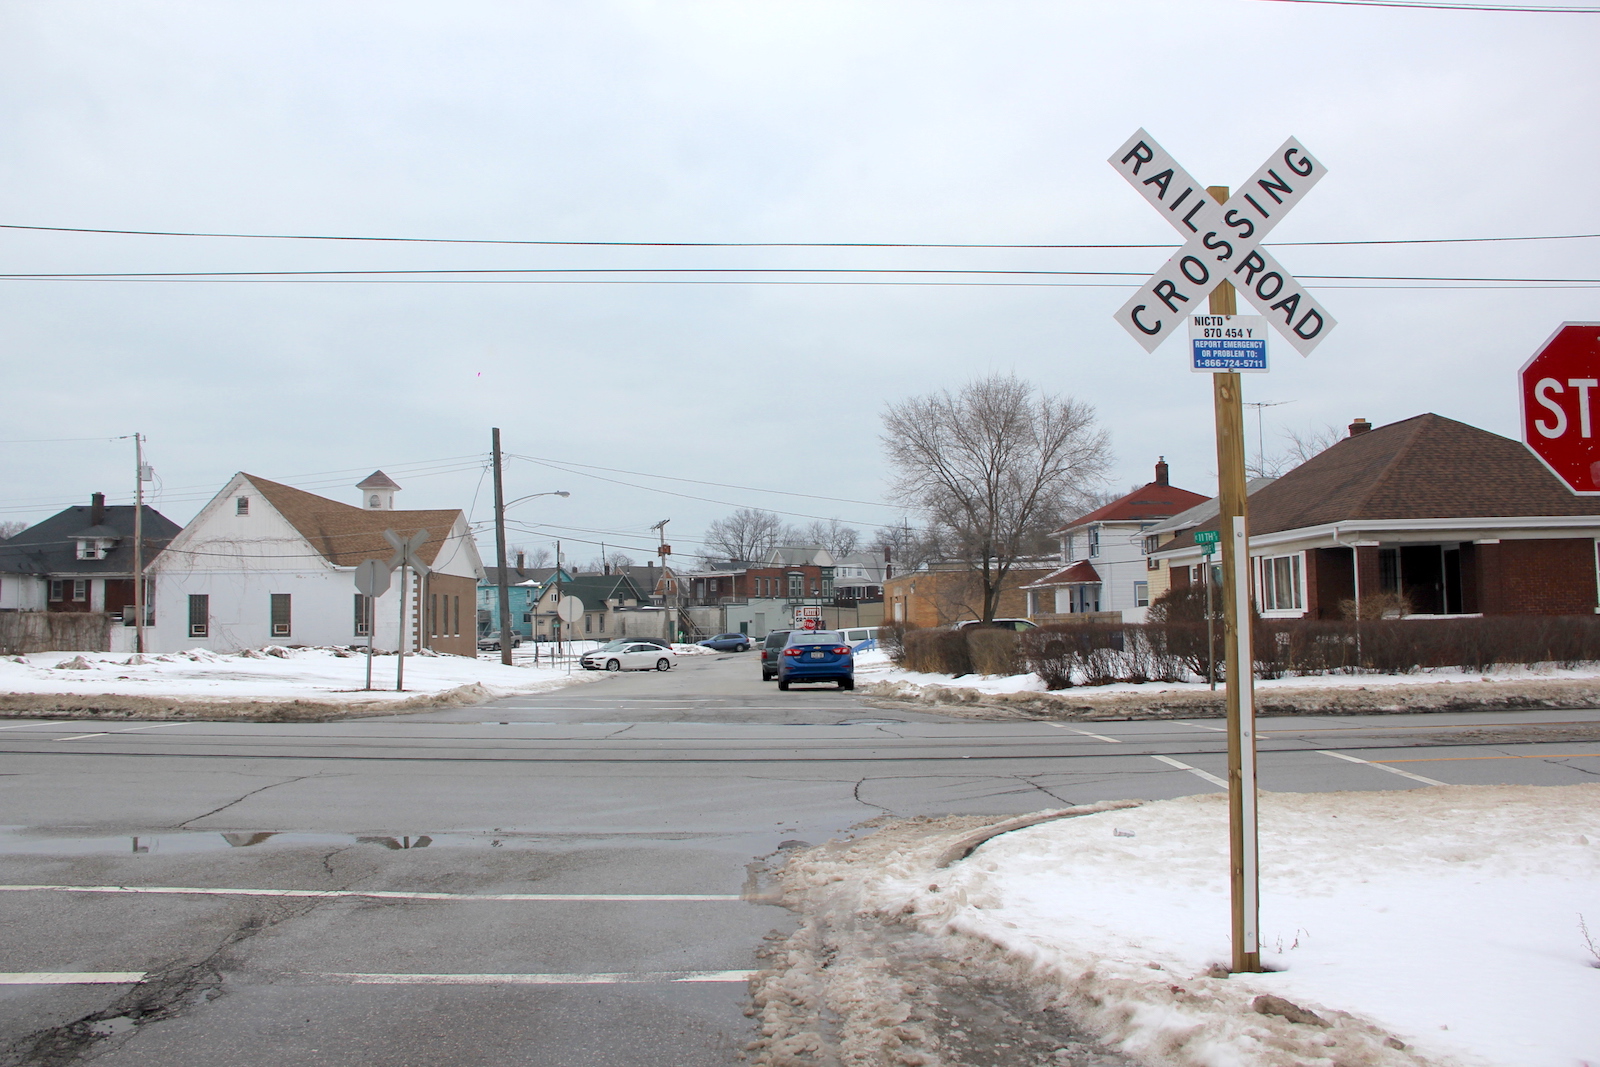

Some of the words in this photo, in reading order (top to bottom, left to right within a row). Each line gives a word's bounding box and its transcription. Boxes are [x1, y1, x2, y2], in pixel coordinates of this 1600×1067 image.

[1121, 140, 1205, 233] RAIL
[1131, 148, 1313, 335] CROSSING
[1234, 250, 1323, 340] ROAD
[1194, 316, 1223, 326] NICTD
[1204, 328, 1222, 338] 870
[1225, 328, 1243, 338] 454
[1246, 328, 1253, 338] Y
[1195, 340, 1222, 348] REPORT
[1223, 340, 1263, 349] EMERGENCY
[1213, 350, 1244, 358] PROBLEM
[1246, 350, 1258, 358] TO:
[1196, 359, 1263, 368] 1-866-724-5711
